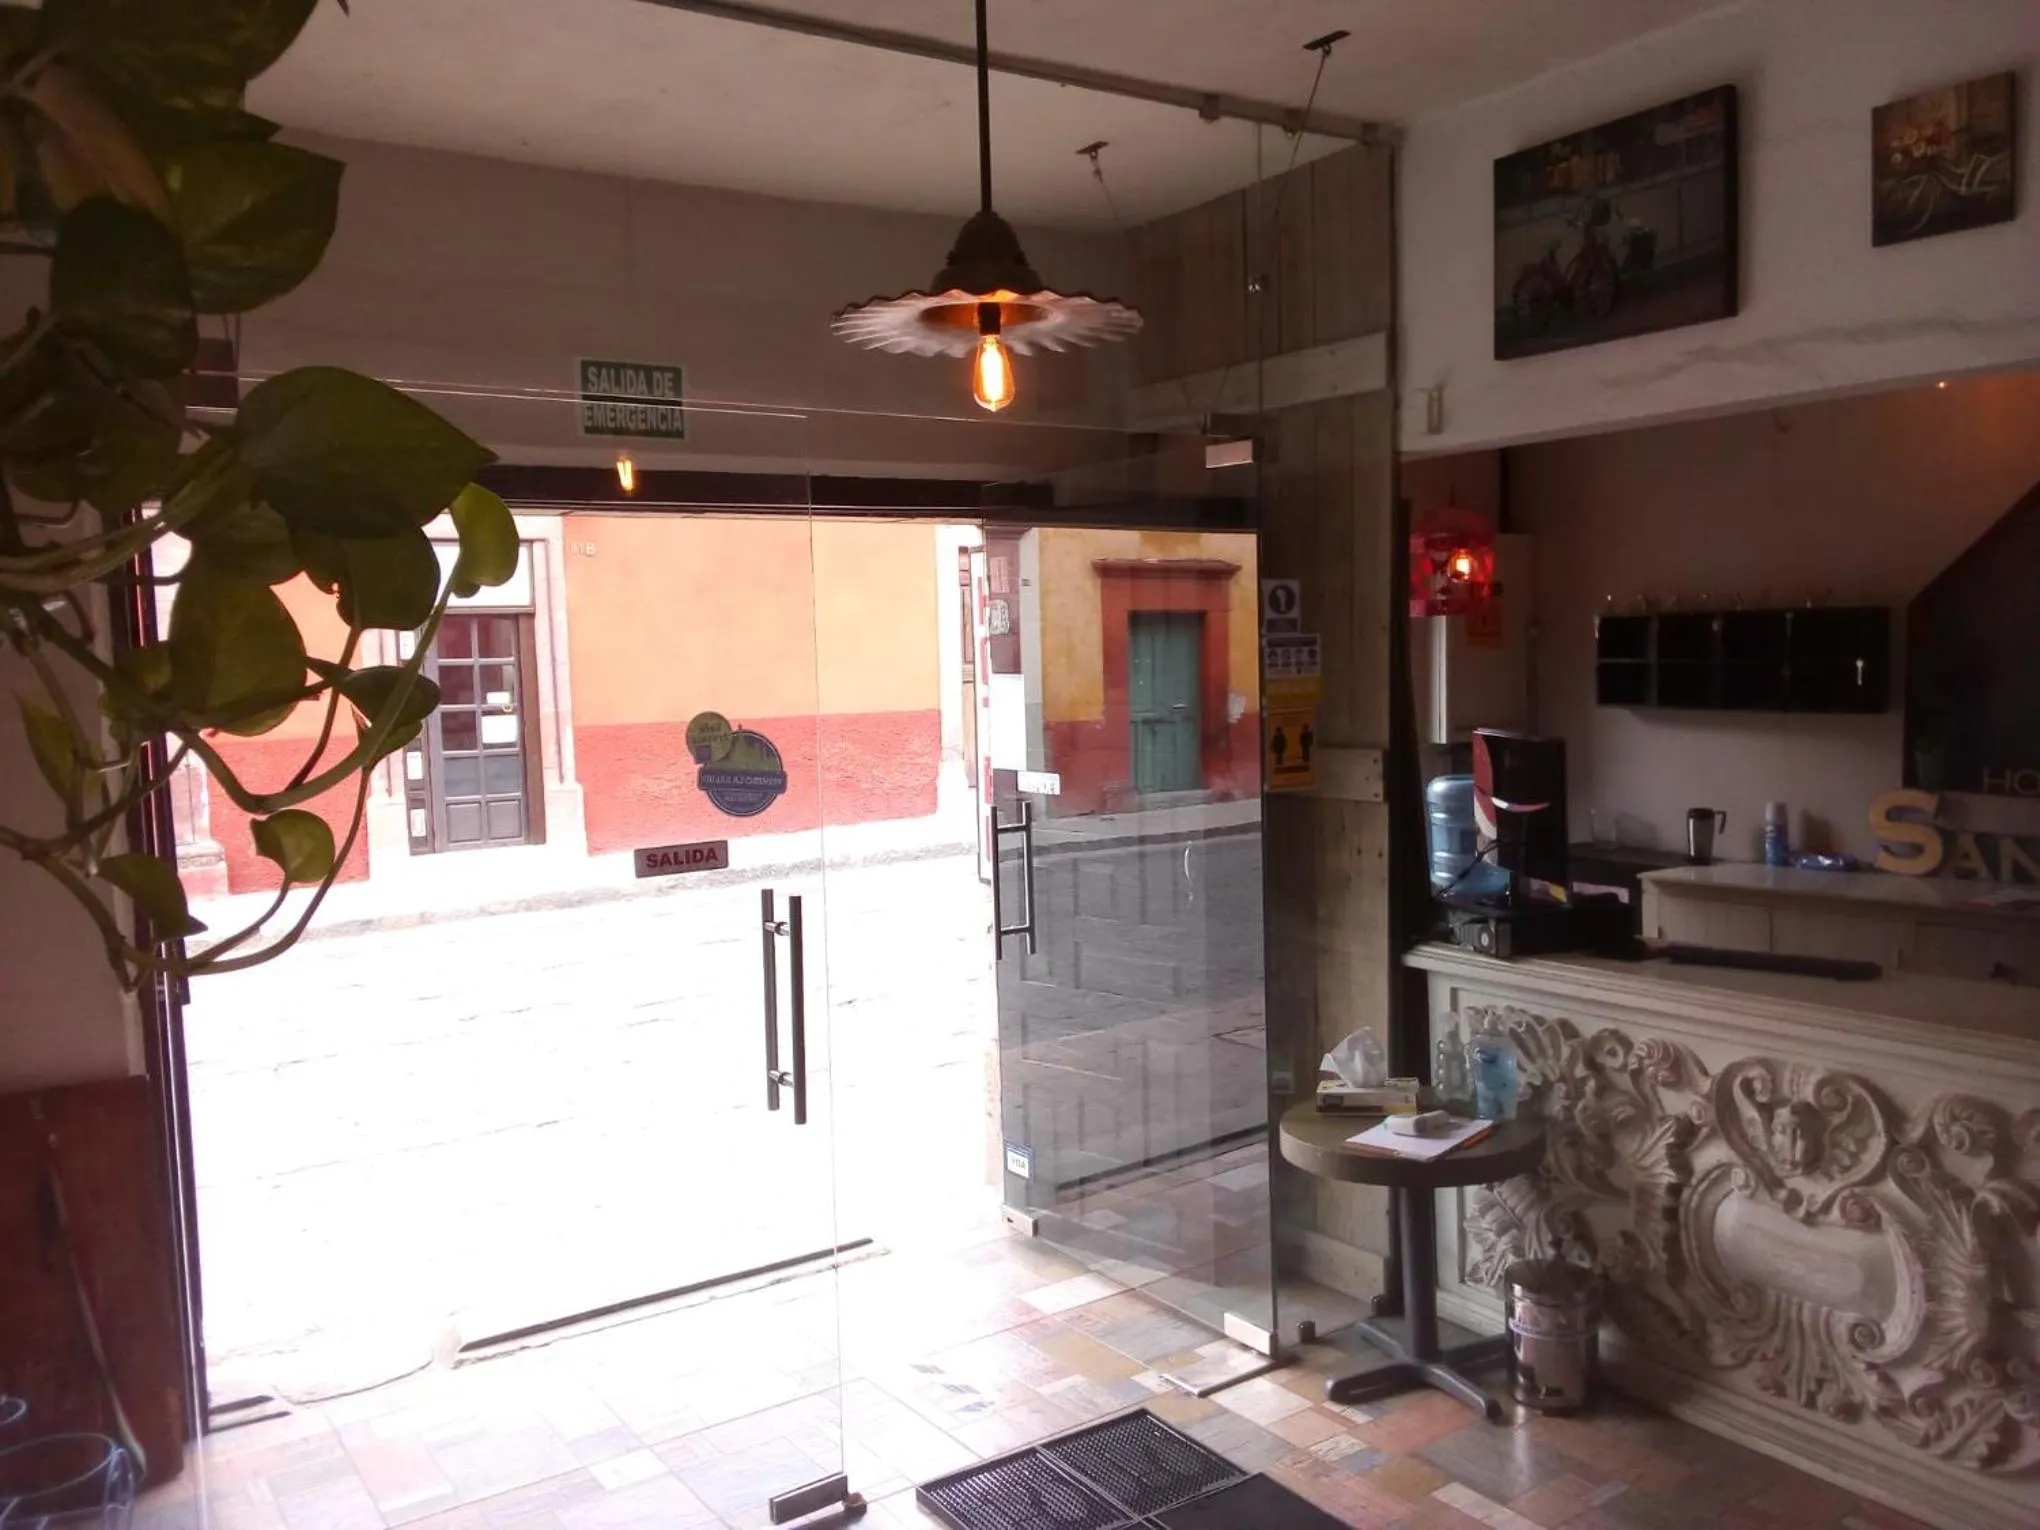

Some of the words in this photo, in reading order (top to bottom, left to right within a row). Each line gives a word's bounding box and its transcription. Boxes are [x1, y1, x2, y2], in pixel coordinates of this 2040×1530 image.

[587, 366, 648, 395] SALIDA
[653, 371, 675, 397] DE
[584, 403, 683, 430] EMERGENCIA
[646, 847, 719, 869] SALIDA
